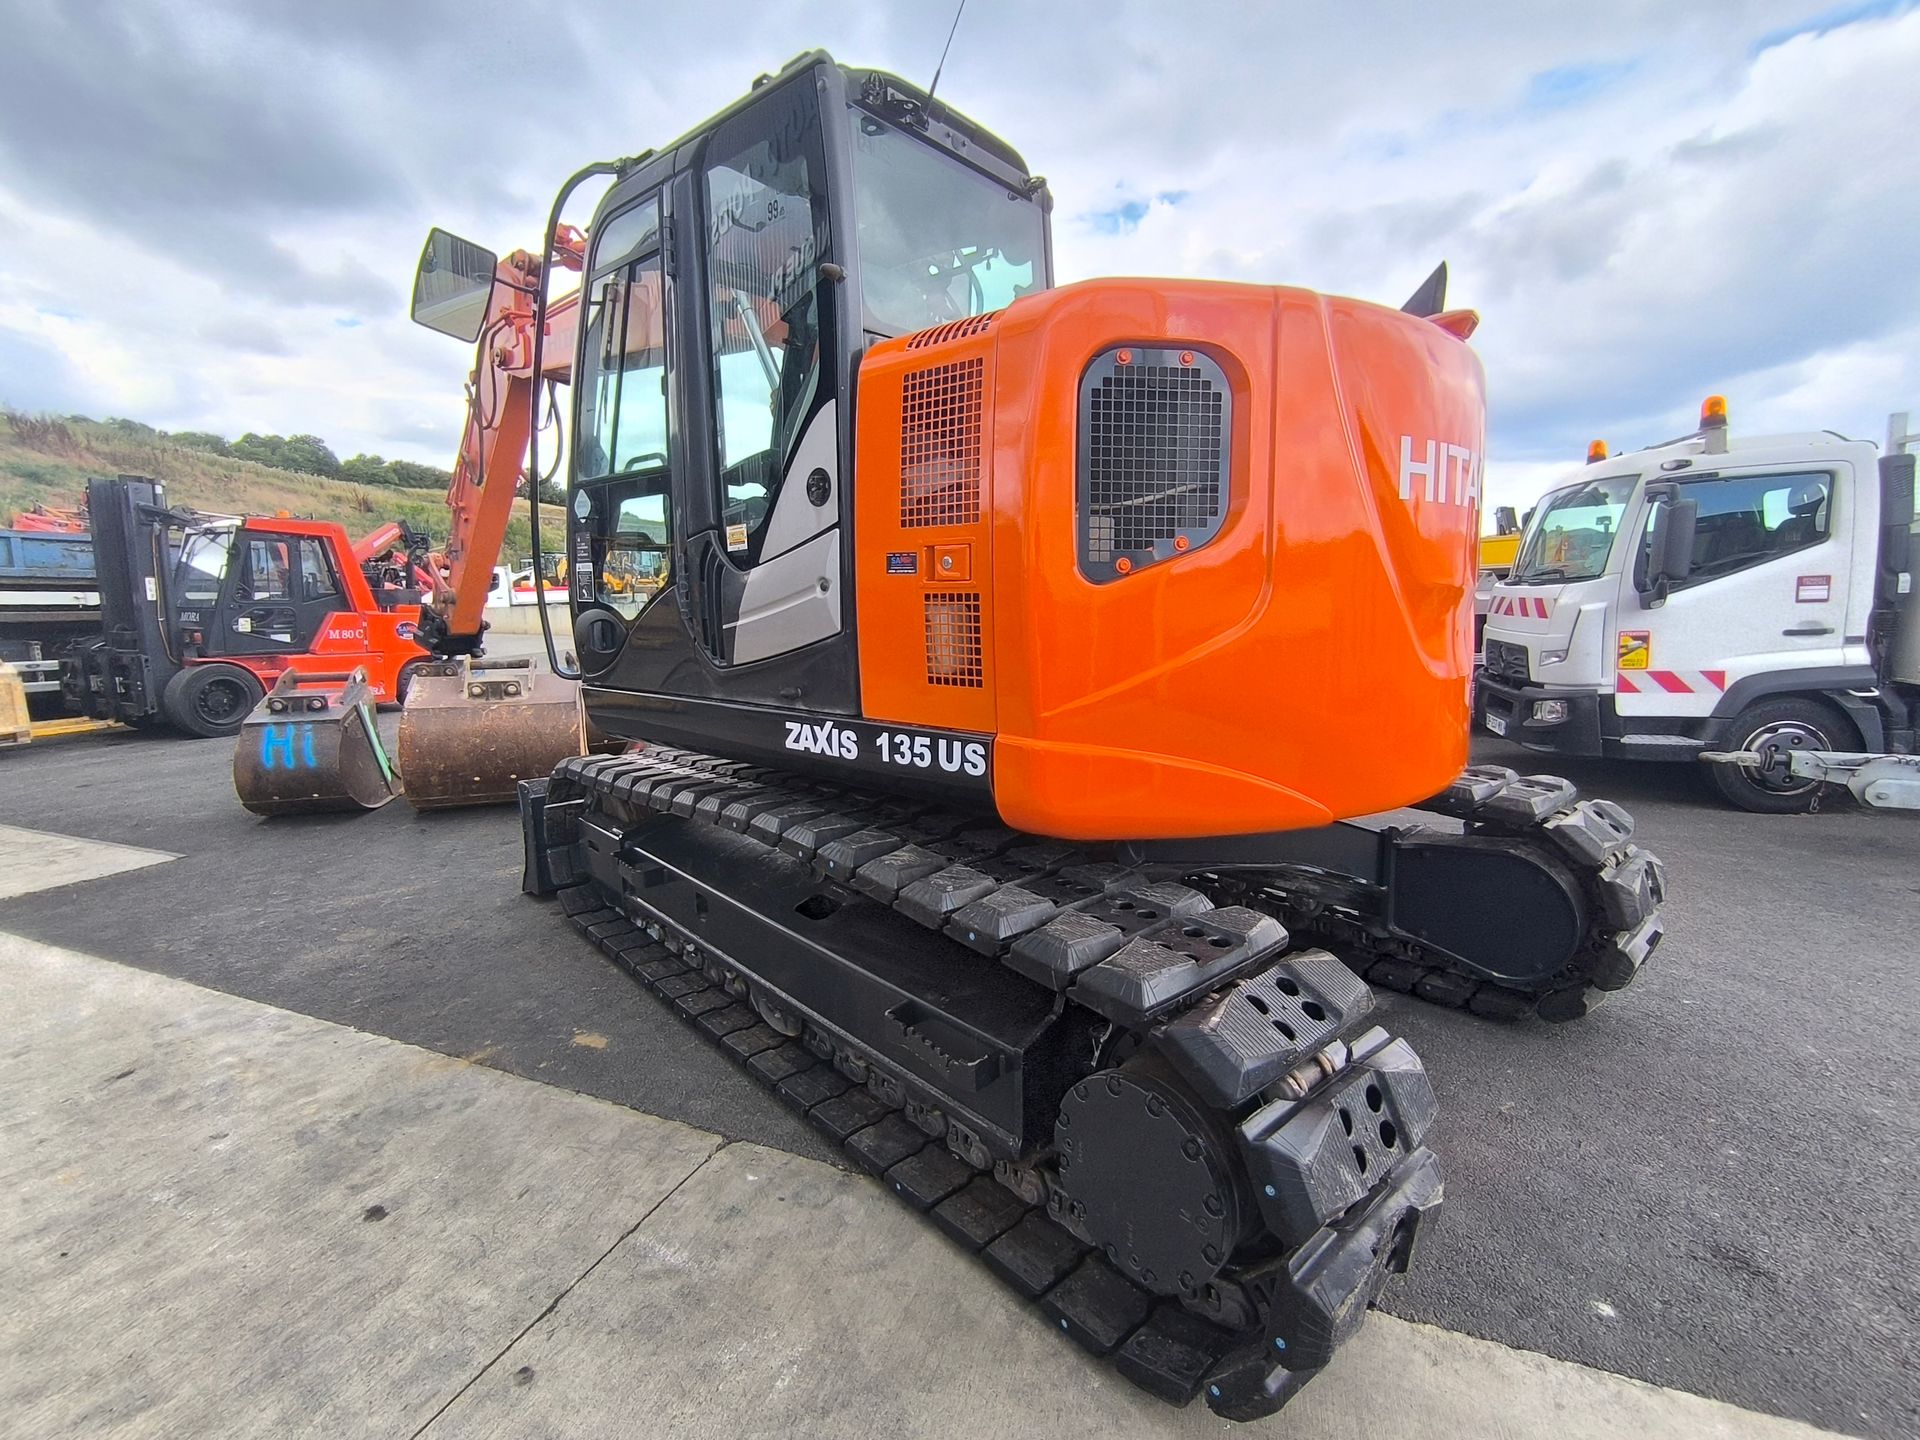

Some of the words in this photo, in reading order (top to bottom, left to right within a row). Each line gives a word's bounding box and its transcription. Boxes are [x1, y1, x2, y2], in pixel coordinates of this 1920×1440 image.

[767, 200, 779, 221] 99
[1399, 435, 1483, 511] HITA
[328, 629, 340, 639] M
[341, 629, 355, 639] 80
[355, 628, 365, 639] C
[785, 720, 860, 760] ZAXIS
